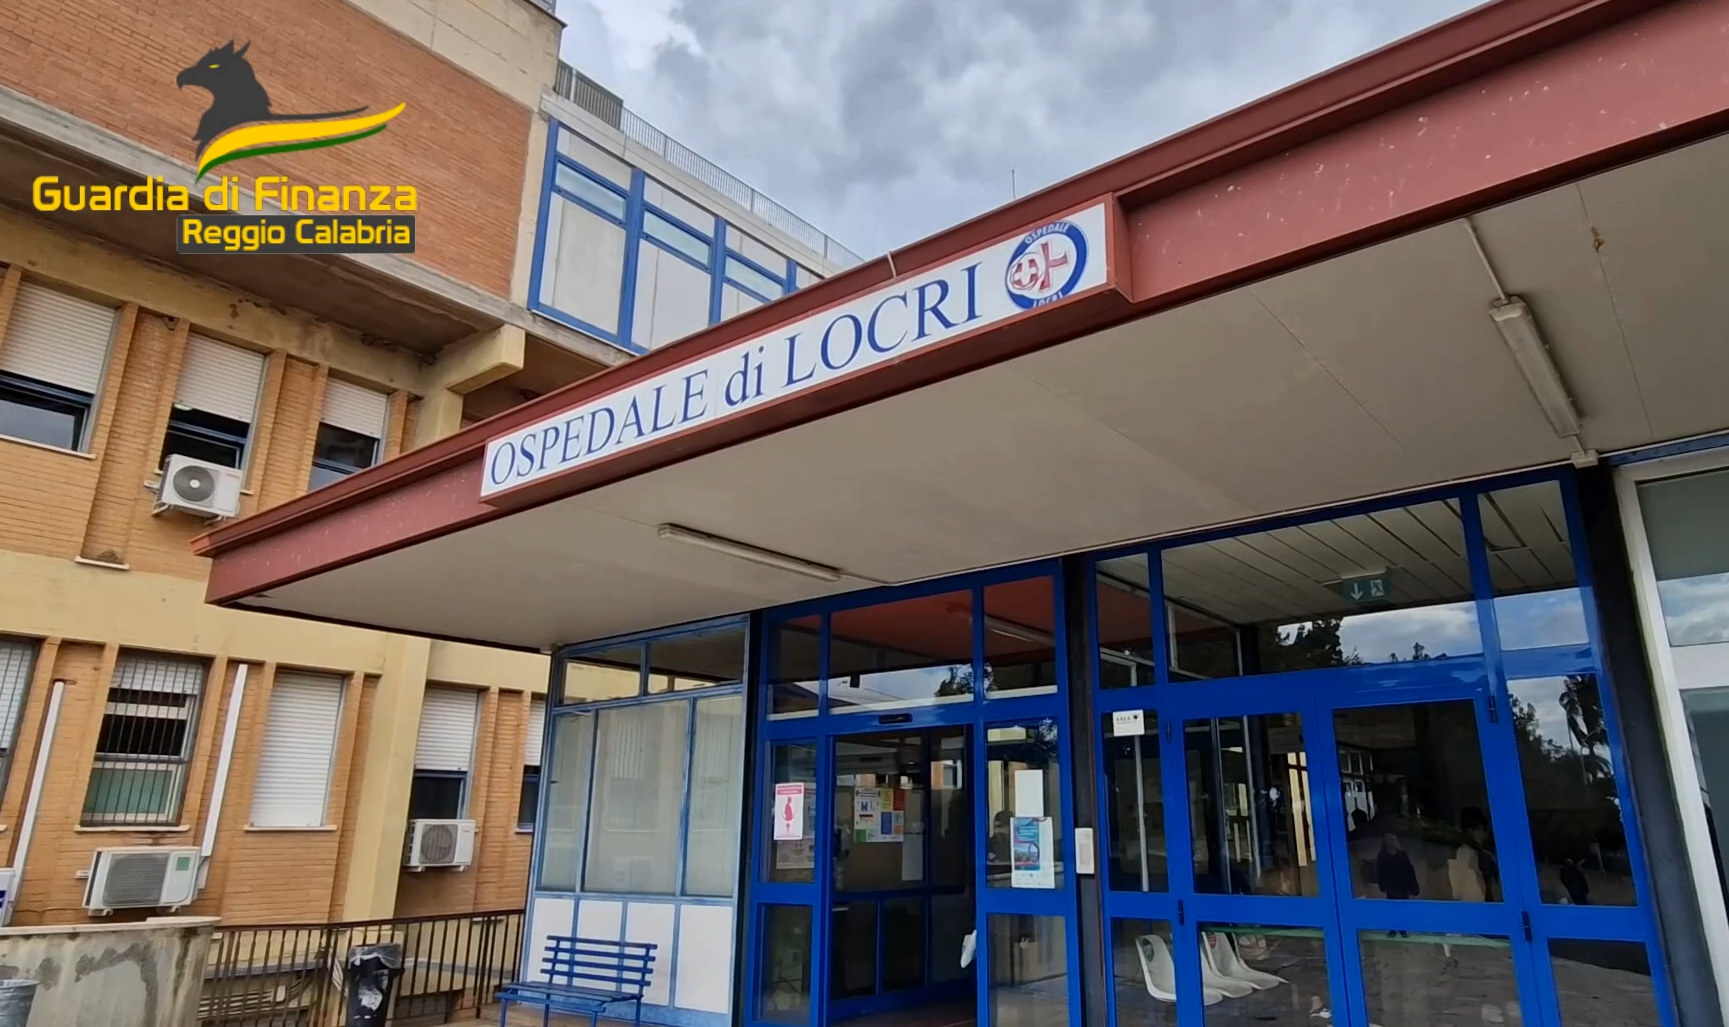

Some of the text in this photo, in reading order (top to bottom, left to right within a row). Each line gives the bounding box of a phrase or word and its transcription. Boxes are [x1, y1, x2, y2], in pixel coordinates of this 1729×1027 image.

[1026, 223, 1071, 243] OSPEDALE
[490, 261, 983, 485] OSPEDALE di LOCRI
